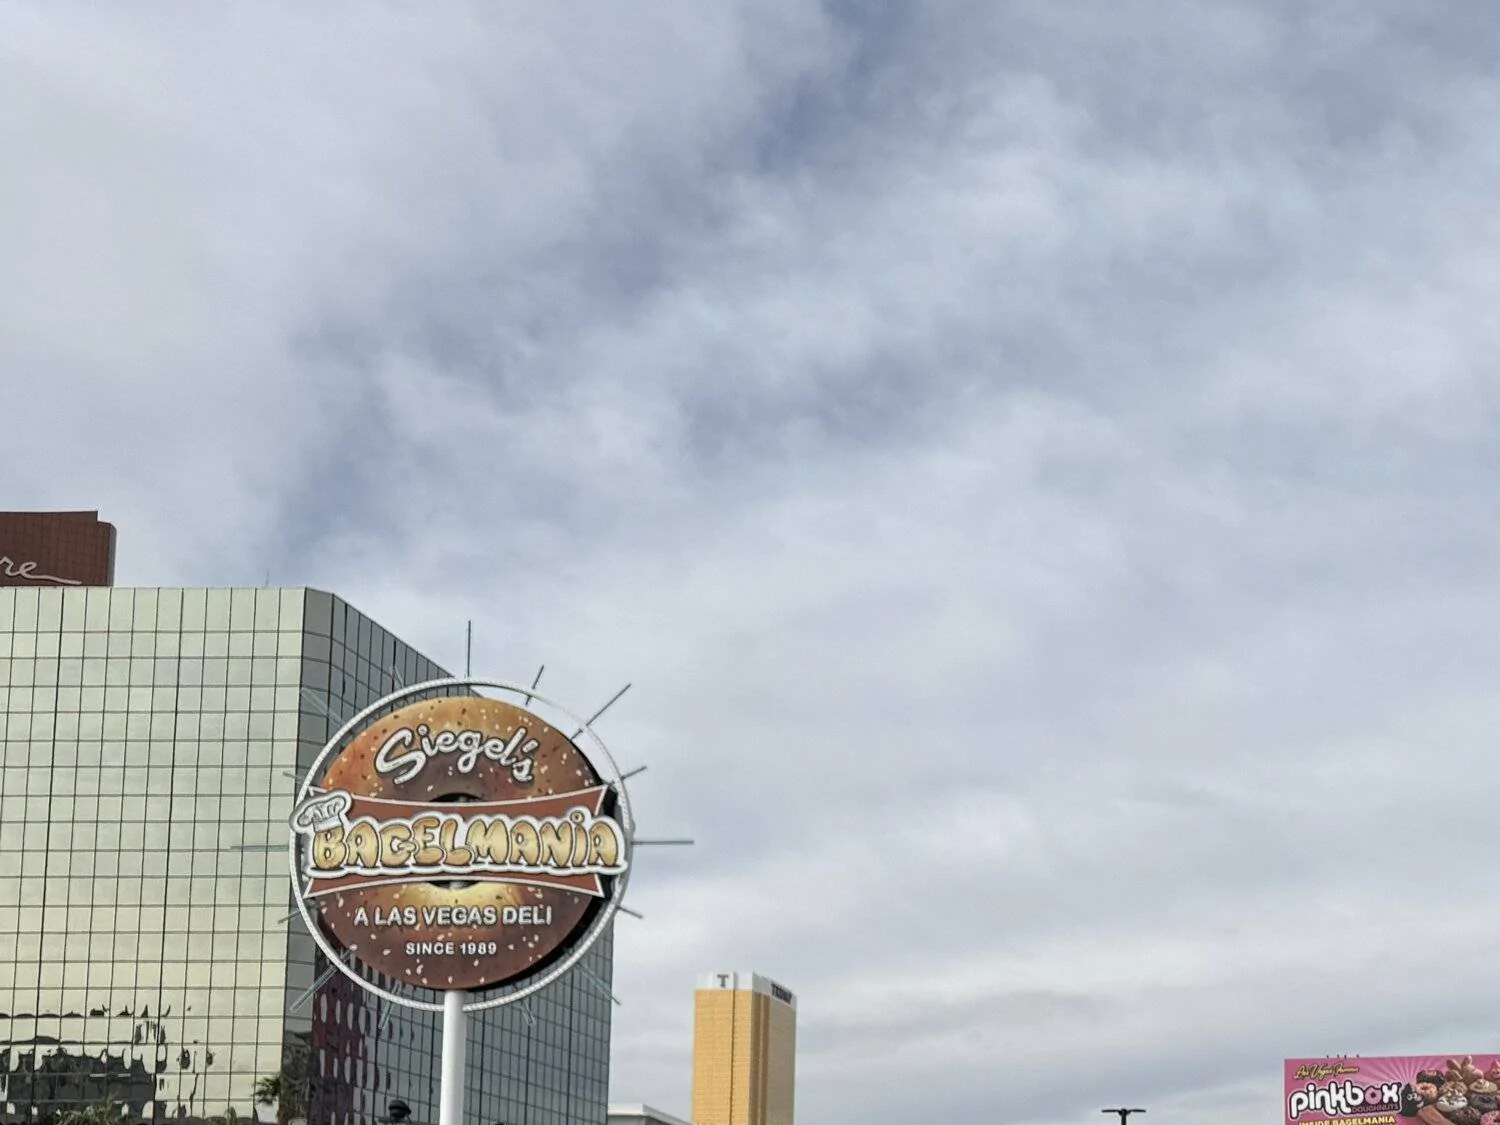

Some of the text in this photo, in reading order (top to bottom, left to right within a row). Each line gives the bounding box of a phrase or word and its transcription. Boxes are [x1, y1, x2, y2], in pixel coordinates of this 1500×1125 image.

[375, 725, 539, 784] Siegel's
[354, 905, 552, 926] A LAS VEGAS DELI
[405, 941, 497, 955] SINCE 1989
[1290, 1081, 1402, 1119] pinkbox
[1351, 1103, 1399, 1113] DOUGHNUTS
